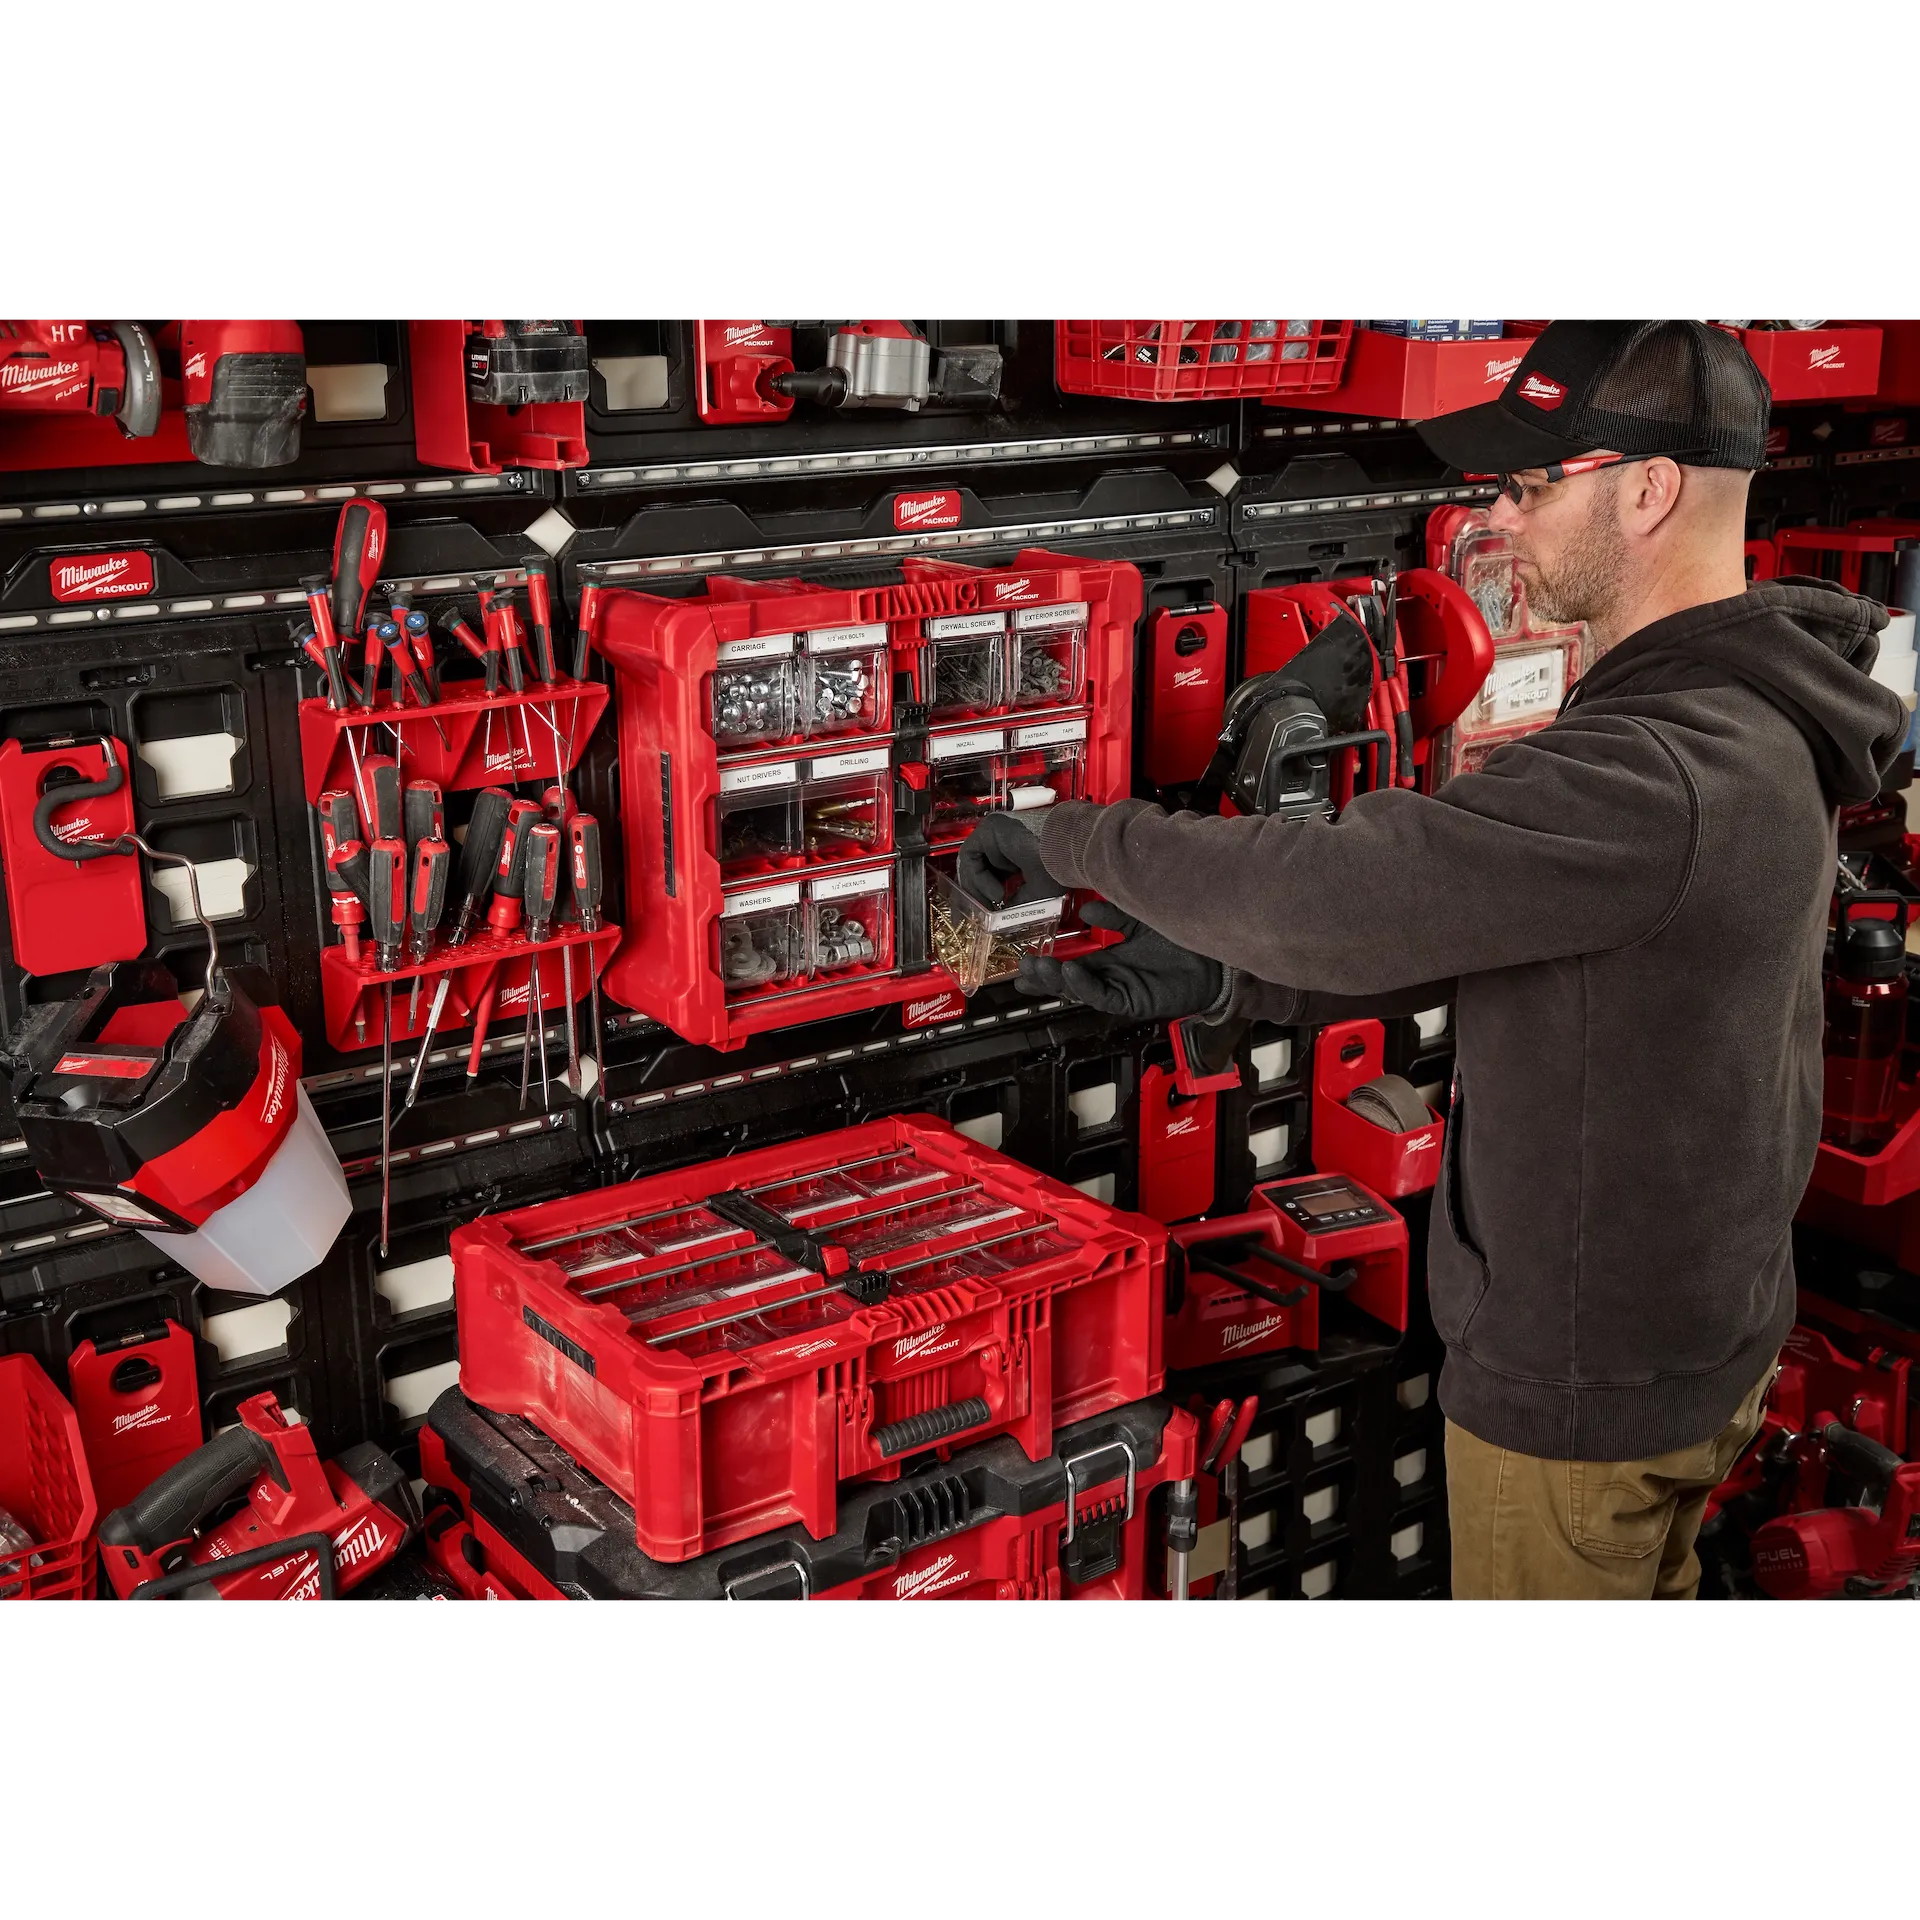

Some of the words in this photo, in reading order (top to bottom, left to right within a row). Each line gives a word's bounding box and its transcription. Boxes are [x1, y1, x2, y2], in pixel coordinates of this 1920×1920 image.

[724, 324, 764, 341] Milwaukee
[1809, 344, 1840, 364] Milwaukee
[0, 361, 80, 386] Milwaukee
[146, 371, 153, 381] F
[55, 381, 88, 401] FUEL
[1525, 376, 1561, 395] Milwaukee
[898, 495, 947, 520] Milwaukee
[922, 516, 958, 526] PACKOUT
[56, 557, 129, 590] Milwaukee
[95, 582, 149, 595] PACKOUT
[994, 578, 1030, 598] Milwaukee
[1012, 593, 1039, 601] PACKOUT
[1024, 612, 1053, 622] EXTERIOR
[1054, 608, 1079, 618] SCREWS
[940, 622, 968, 631] DRYWALL
[970, 619, 996, 629] SCREWS
[837, 633, 848, 641] HEX
[848, 632, 865, 640] BOLTS
[731, 642, 766, 653] CARRIAGE
[1173, 667, 1202, 684] Milwaukee
[1024, 731, 1049, 740] FASTBACK
[1062, 727, 1074, 735] TAPE
[956, 740, 975, 749] INKZALL
[485, 747, 525, 770] Milwakee
[503, 761, 537, 771] PAKOUT
[839, 757, 869, 766] DRILLING
[737, 775, 750, 784] NUT
[752, 768, 781, 781] DRIVERS
[50, 817, 90, 837] ilwaukee
[841, 881, 852, 889] HEX
[852, 879, 866, 888] NUTS
[739, 896, 772, 908] WASHERS
[1001, 912, 1020, 921] WOOD
[1020, 908, 1046, 918] SCREWS
[906, 993, 951, 1019] Milwaukee
[929, 1008, 963, 1022] PACKOUT
[265, 1035, 289, 1124] Milwaukee
[1166, 1116, 1193, 1134] Milwaukee
[1406, 1133, 1432, 1150] Milwaukee
[1221, 1314, 1283, 1346] Milwaukee
[892, 1323, 946, 1358] Milwaukee
[919, 1339, 960, 1357] PACKOUT
[112, 1402, 159, 1430] Milwaukee
[136, 1414, 172, 1428] PACKOUT
[1756, 1547, 1801, 1563] FUEL
[260, 1550, 309, 1581] FUEL
[892, 1553, 955, 1598] Milwaukee
[923, 1570, 970, 1595] PACKOUT
